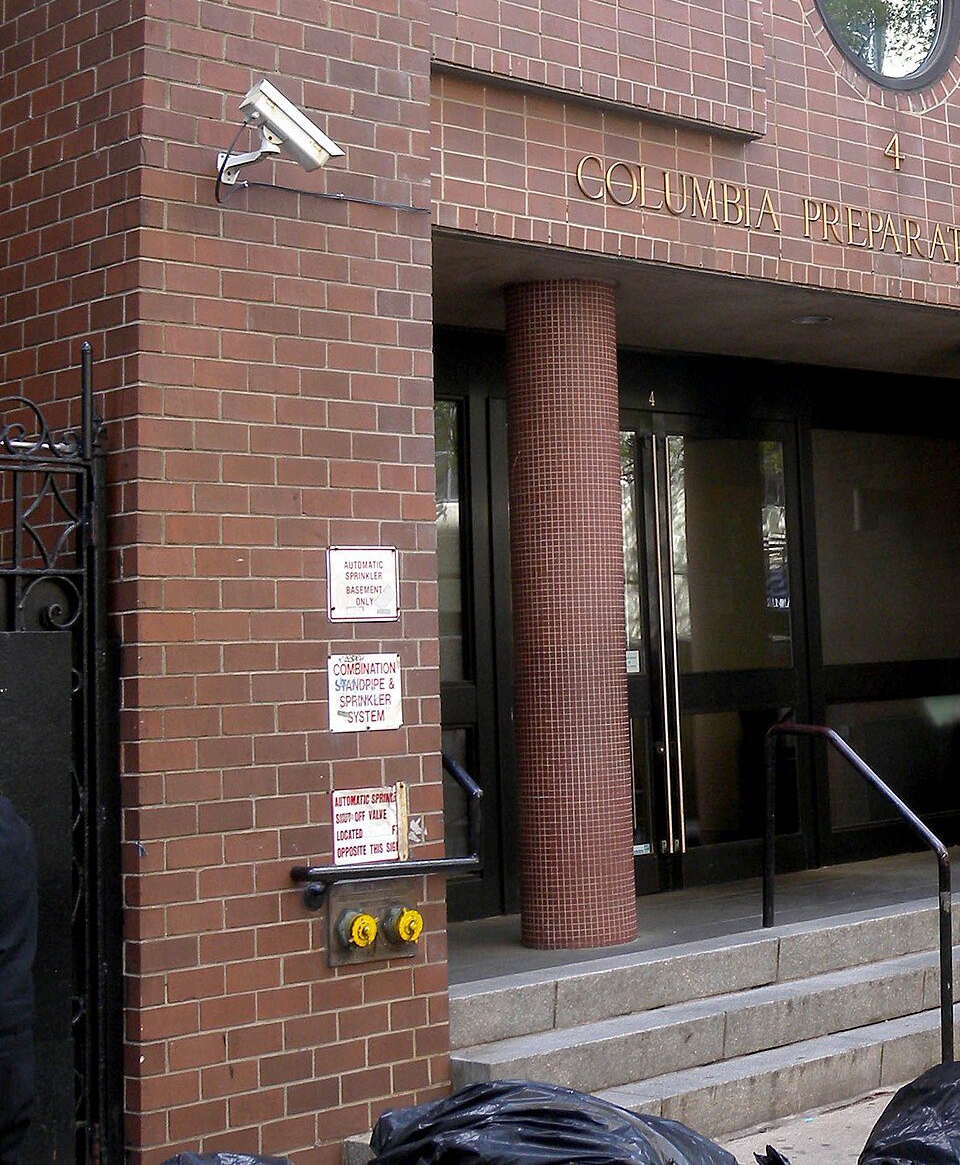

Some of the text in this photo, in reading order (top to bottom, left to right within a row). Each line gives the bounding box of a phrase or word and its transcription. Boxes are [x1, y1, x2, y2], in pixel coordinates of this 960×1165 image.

[884, 133, 905, 171] 4
[576, 155, 781, 232] COLUMBIA
[649, 390, 655, 407] 4
[344, 560, 384, 569] AUTOMATIC
[345, 571, 383, 580] SPRINKLER
[345, 585, 383, 595] BASEMENT
[356, 597, 374, 606] ONLY
[333, 662, 396, 676] COMBINATION
[335, 677, 395, 692] STANDPIPE &
[339, 693, 391, 708] SPRINKLER
[347, 709, 385, 724] SYSTEM
[335, 794, 370, 807] AUTOMATIC
[368, 809, 387, 821] VALVE
[336, 828, 363, 841] LOCATED
[337, 844, 366, 858] OPPOSITE
[370, 843, 384, 854] THIS
